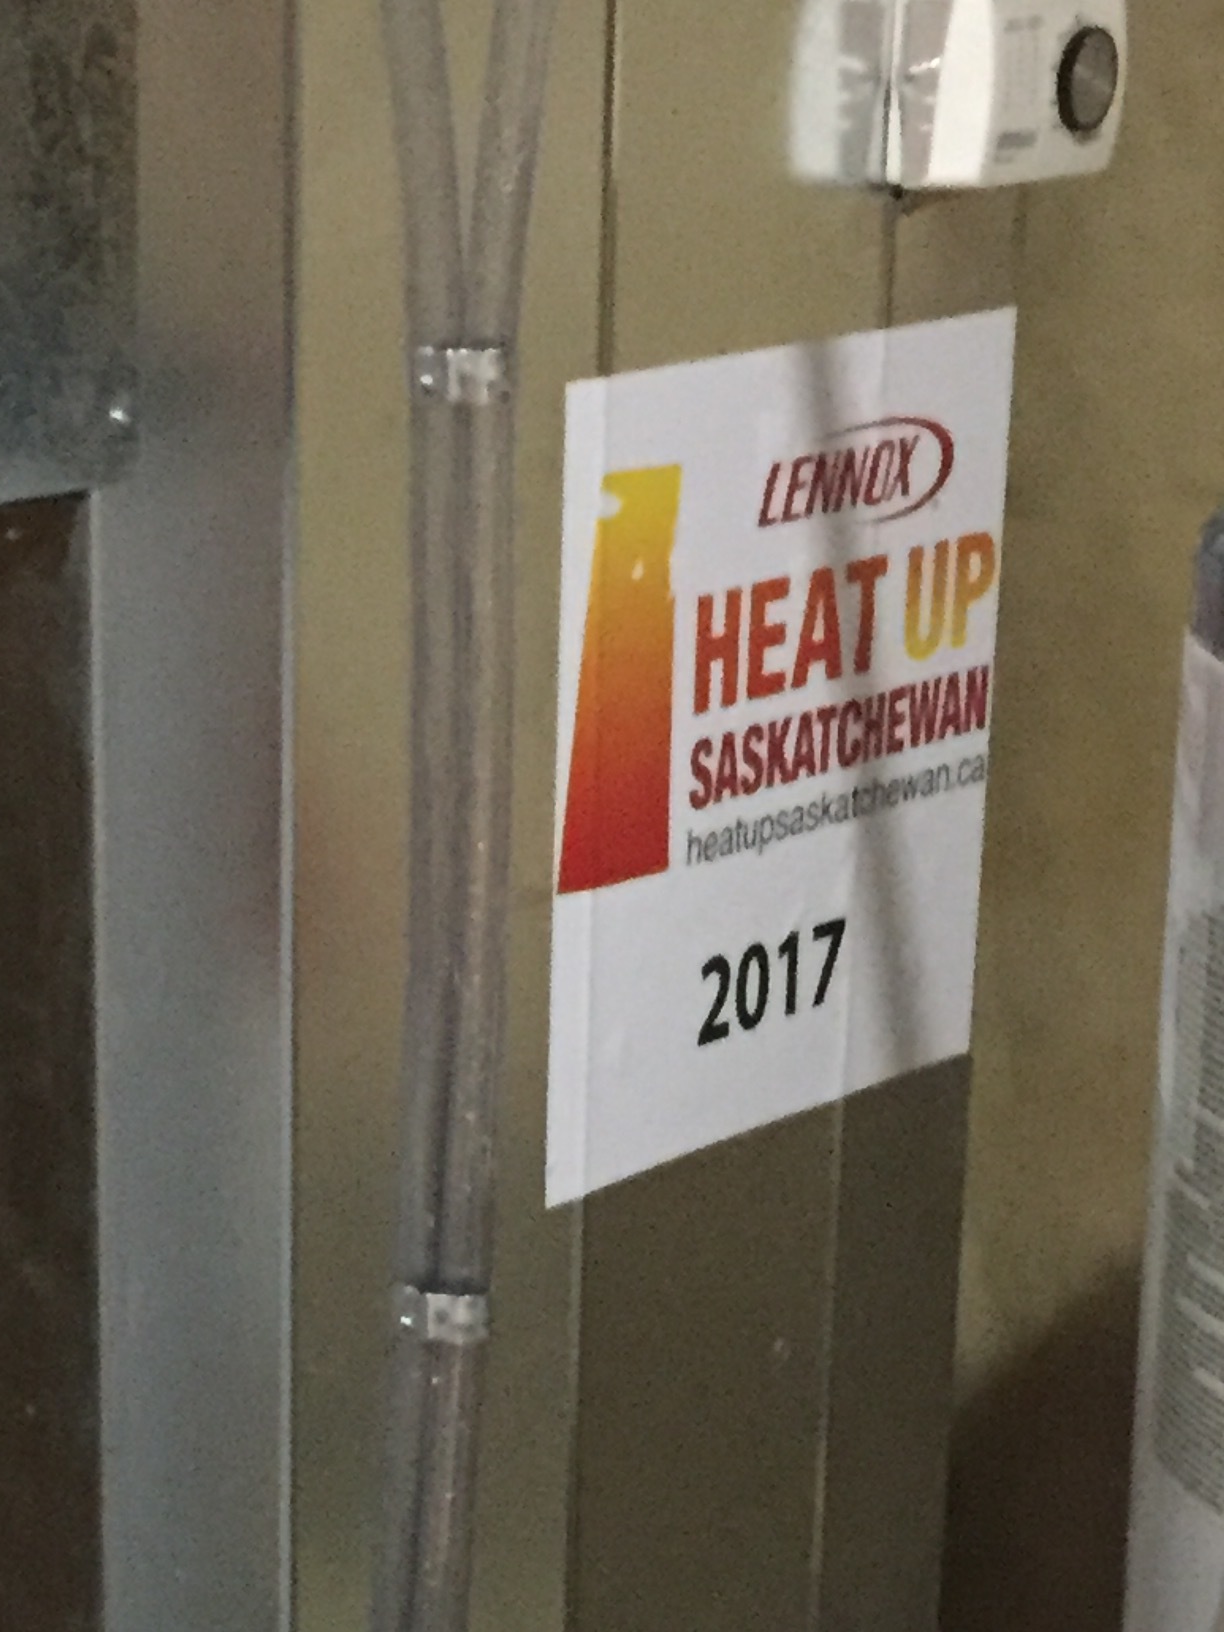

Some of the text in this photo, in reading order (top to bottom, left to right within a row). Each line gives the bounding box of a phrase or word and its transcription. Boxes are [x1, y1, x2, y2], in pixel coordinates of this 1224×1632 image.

[757, 434, 921, 527] LENNOX
[693, 532, 996, 715] HEAT UP
[689, 665, 990, 811] SASKATCHEWAN
[686, 755, 986, 866] heatupsaskatchewan.ca
[697, 918, 847, 1047] 2017
